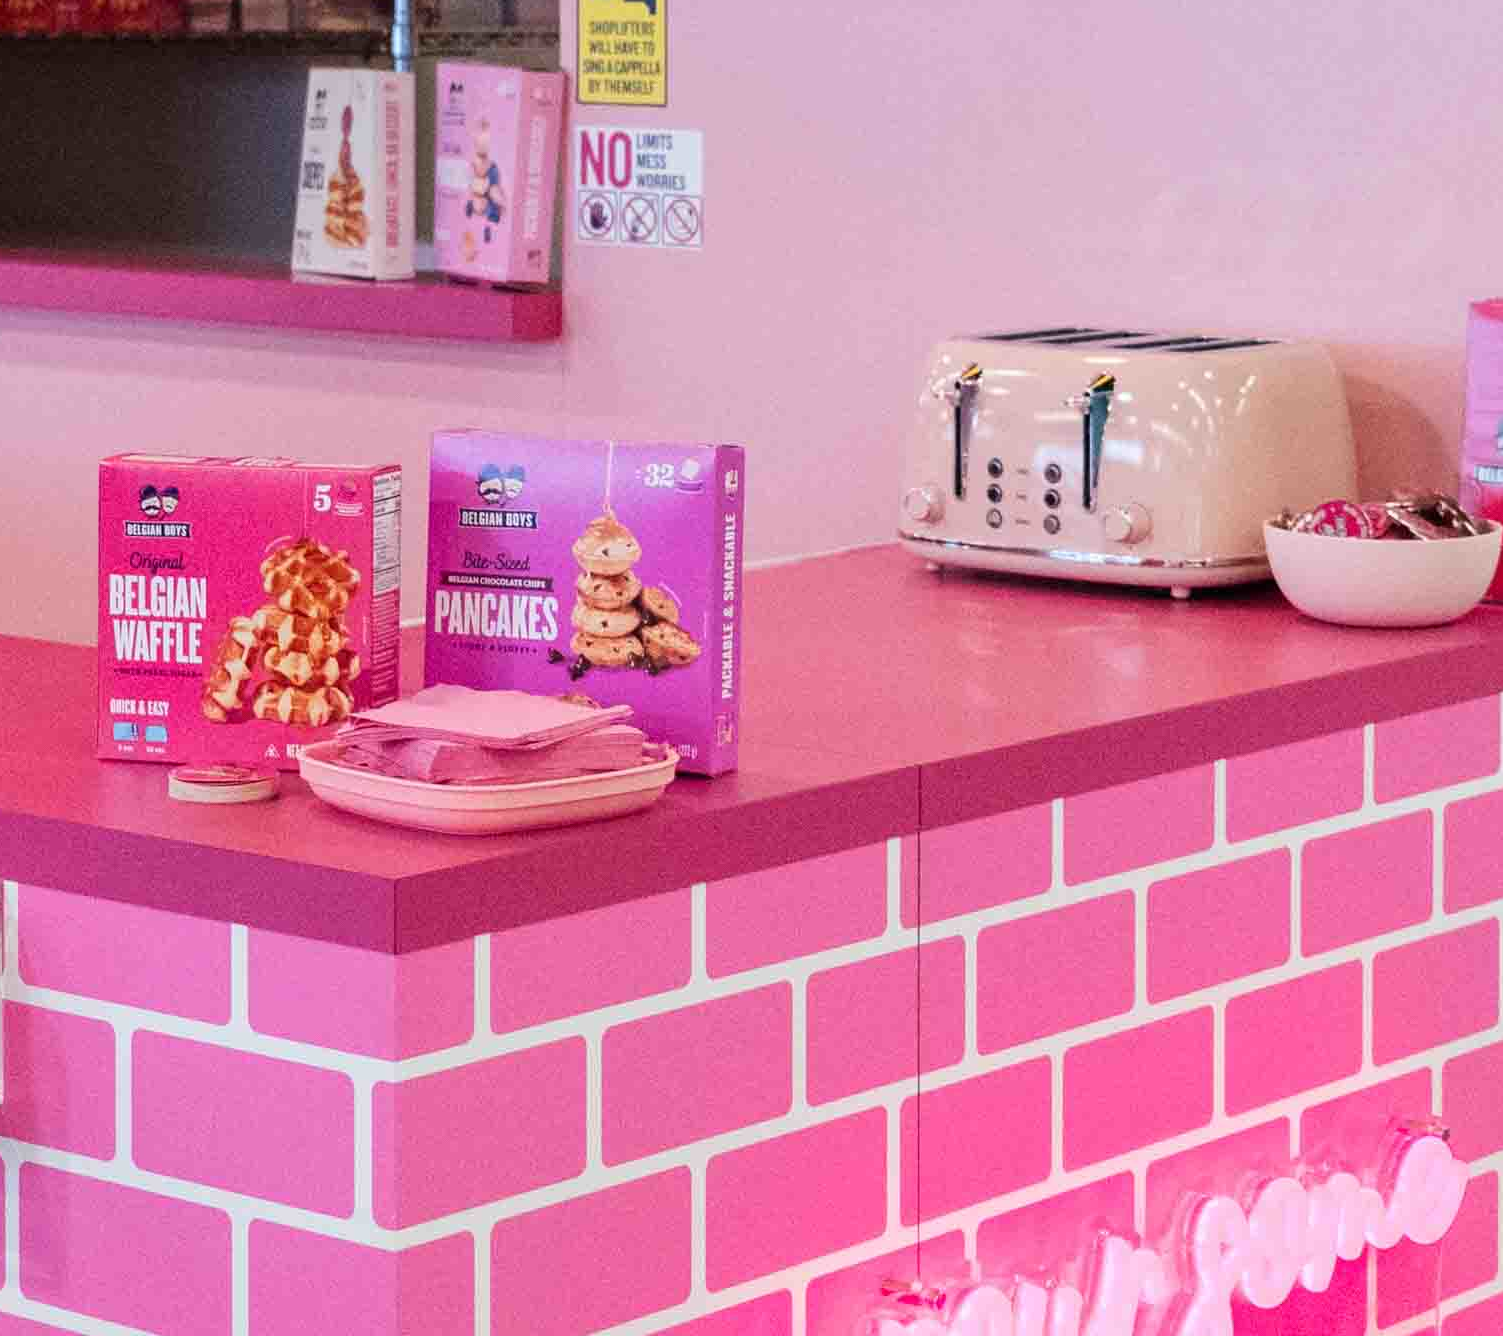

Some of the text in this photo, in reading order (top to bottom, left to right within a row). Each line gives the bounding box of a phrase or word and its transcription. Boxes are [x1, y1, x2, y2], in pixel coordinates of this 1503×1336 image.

[589, 20, 656, 37] SHOPLIFTERS
[589, 40, 655, 56] WILL HAVE TO
[588, 79, 655, 96] BY THEMSELF
[580, 130, 673, 189] NO LIMITS
[635, 154, 668, 170] MESS
[635, 172, 686, 191] WORRIES
[643, 462, 675, 488] 32
[313, 484, 332, 512] 5
[461, 510, 534, 527] BELGIAN BOYS
[126, 524, 188, 537] BELGIAN BOYS
[130, 551, 186, 573] Original
[723, 512, 735, 605] SNACKABLE
[480, 576, 522, 586] CHOCOLATE
[109, 573, 207, 618] BELGIAN
[434, 589, 559, 642] PANCAKES
[113, 619, 203, 664] WAFFLE
[721, 639, 734, 699] PACKABLE
[109, 698, 136, 715] QUICK
[147, 700, 170, 717] EASY
